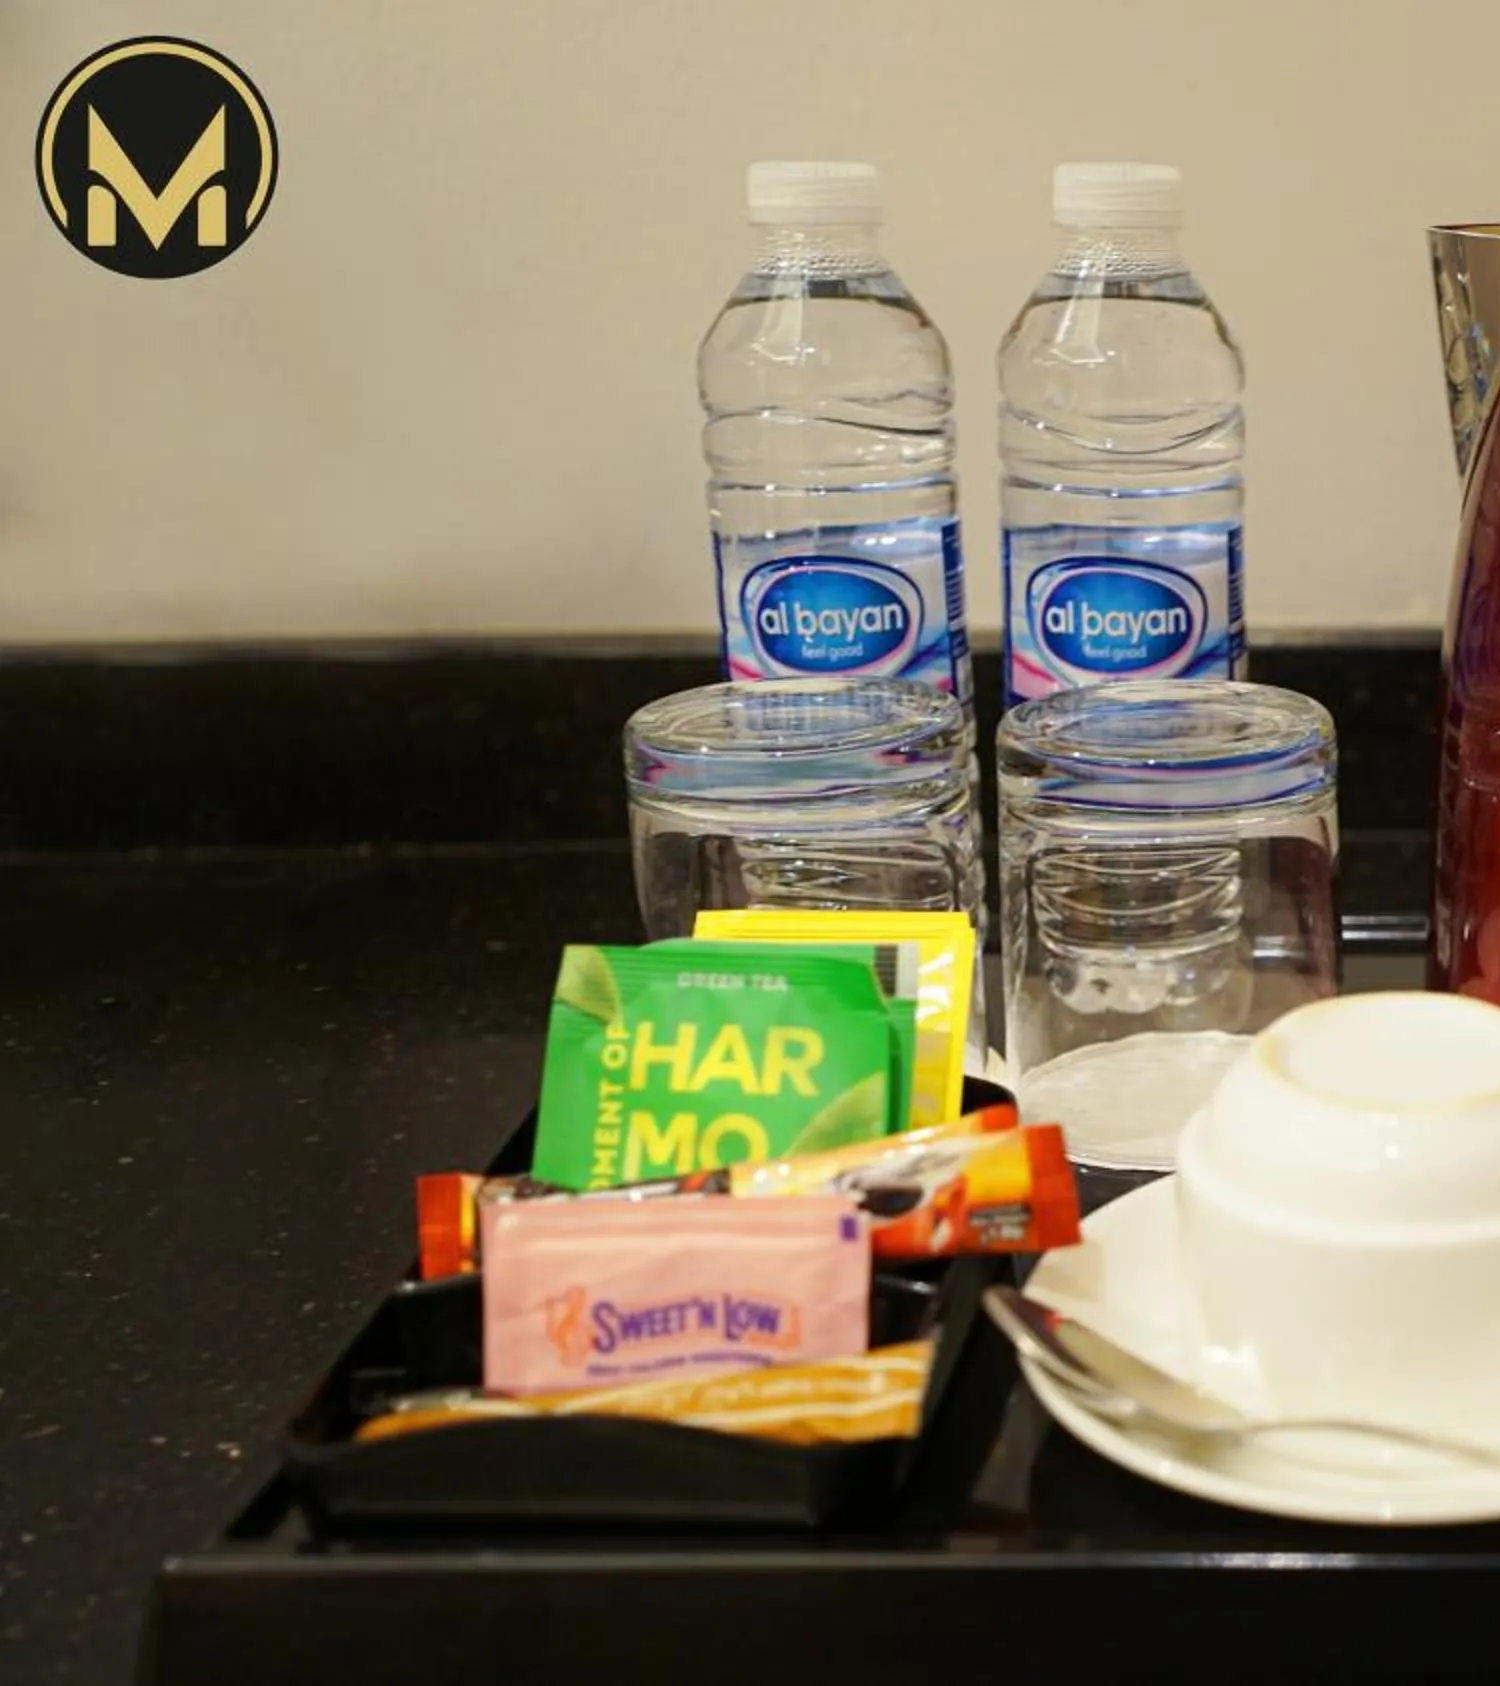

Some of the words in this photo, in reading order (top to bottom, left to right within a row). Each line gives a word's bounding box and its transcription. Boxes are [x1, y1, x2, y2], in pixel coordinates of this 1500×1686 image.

[760, 601, 789, 635] al
[794, 602, 903, 641] bayan
[1046, 601, 1074, 634] al
[1081, 602, 1187, 643] bayan
[802, 643, 826, 658] feel
[829, 643, 863, 662] good
[1082, 643, 1109, 658] feel
[1112, 645, 1147, 662] good
[676, 971, 745, 989] GREEN
[749, 973, 790, 991] TEA
[629, 1021, 824, 1097] HAR
[622, 1110, 769, 1182] MO
